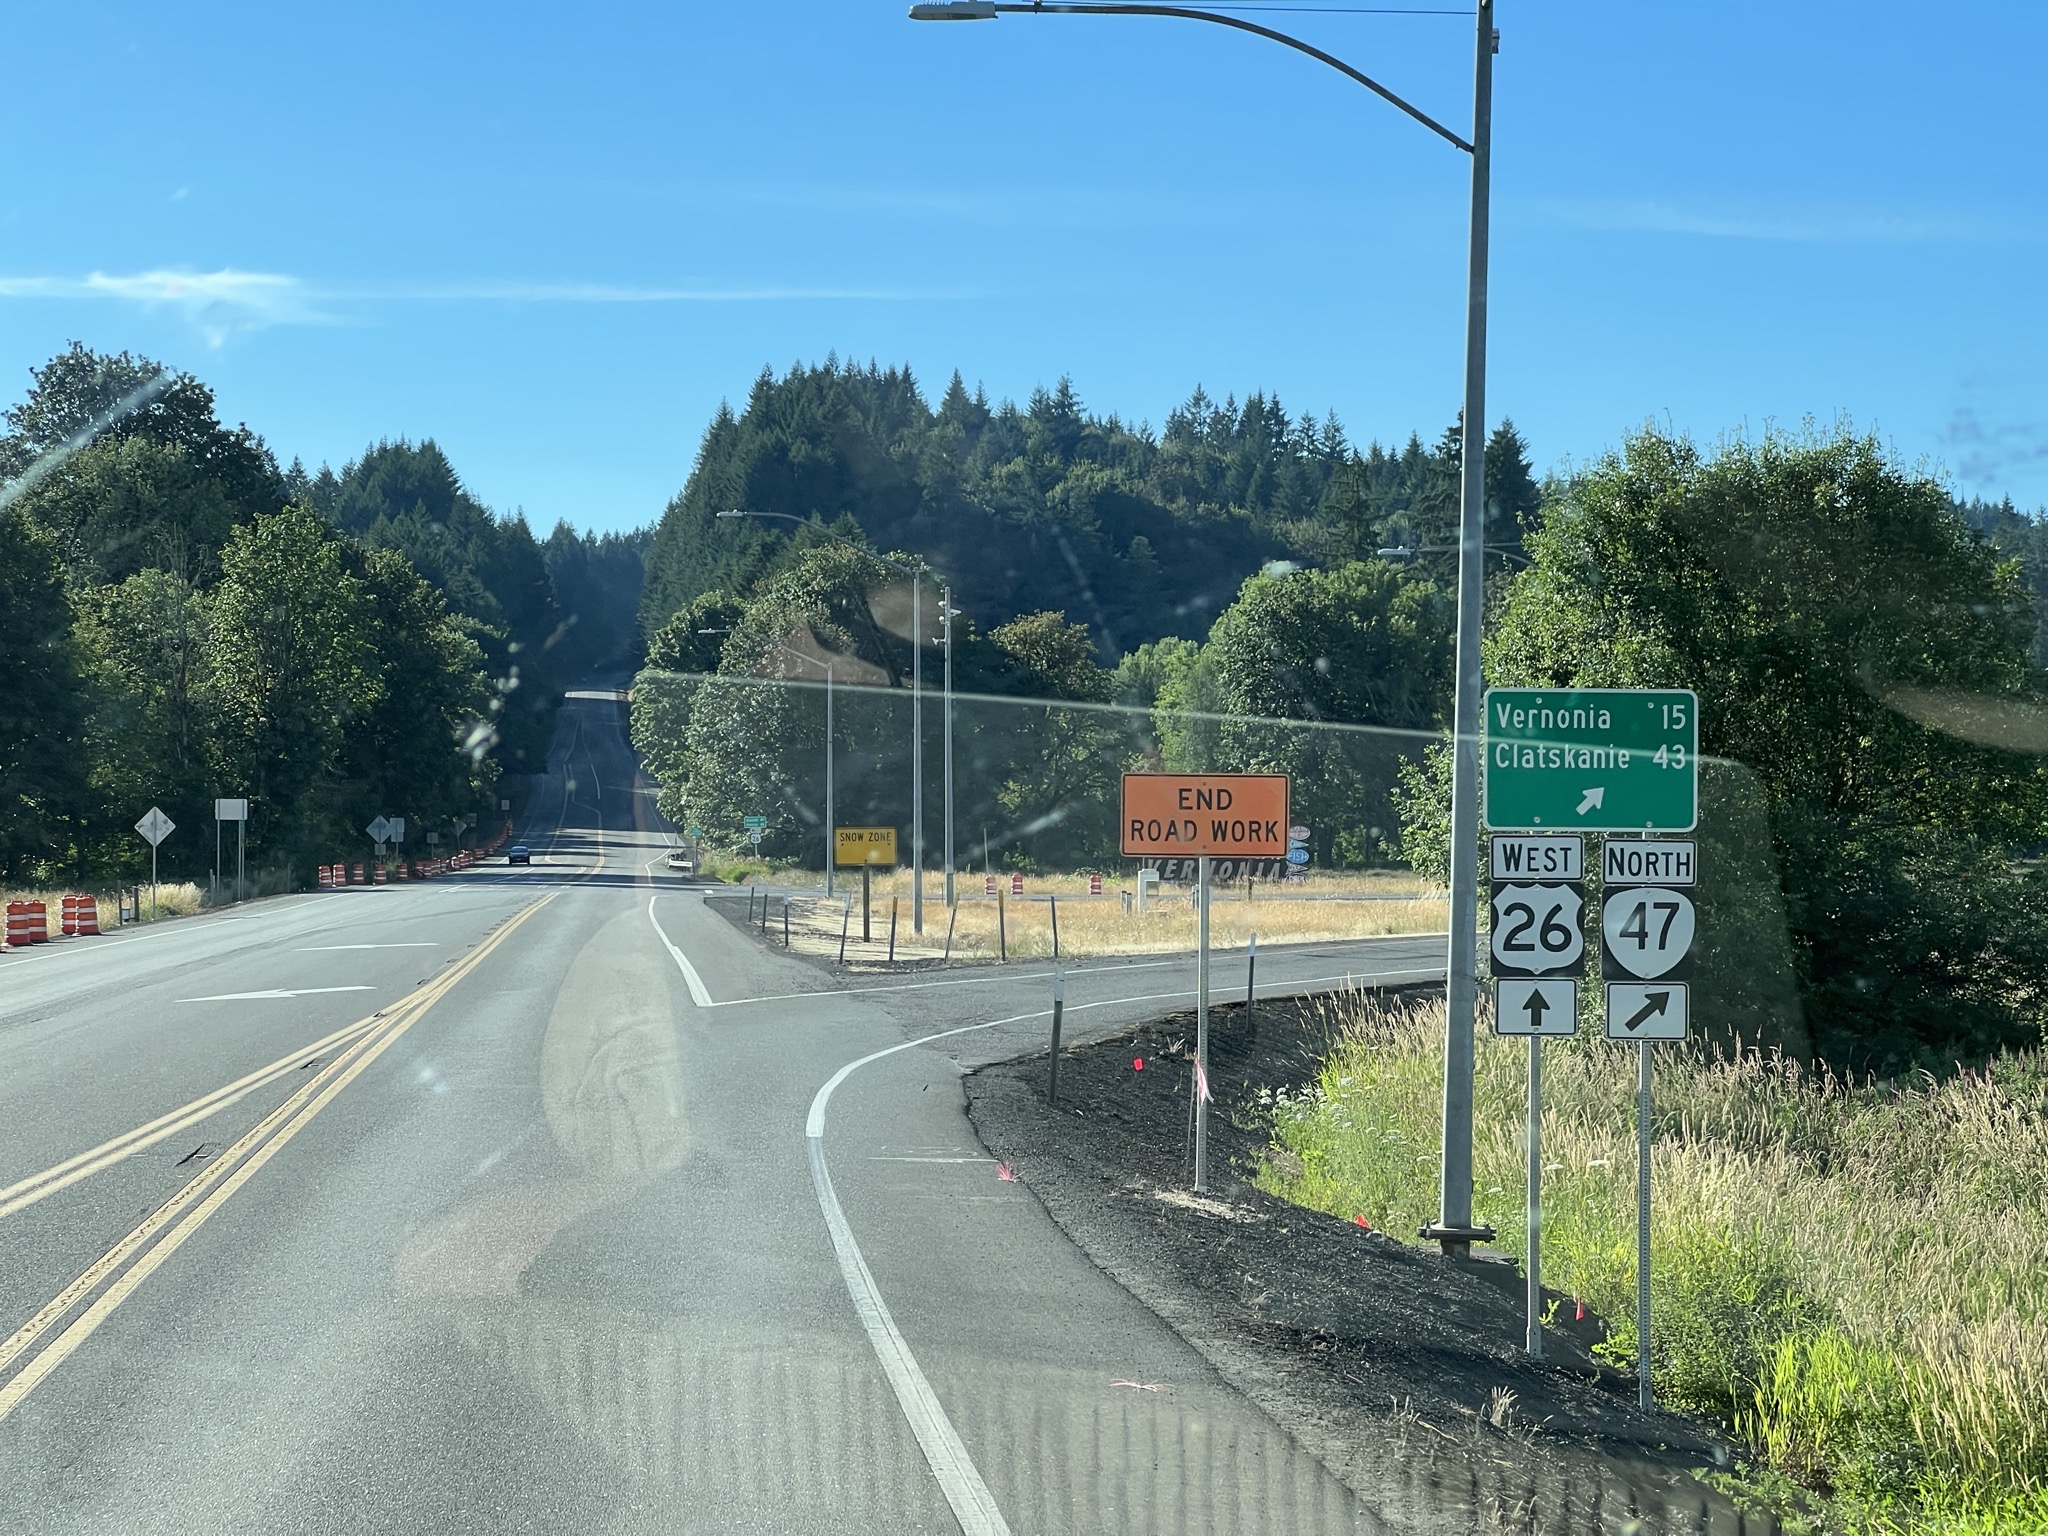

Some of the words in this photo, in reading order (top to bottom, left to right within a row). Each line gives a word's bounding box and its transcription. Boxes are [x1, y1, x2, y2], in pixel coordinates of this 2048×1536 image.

[1496, 703, 1611, 729] Vernonia
[1662, 704, 1686, 730] 15
[1495, 743, 1630, 769] Clatskanie
[1652, 744, 1686, 770] 43
[1178, 788, 1233, 811] END
[840, 832, 864, 842] SNOW
[868, 832, 892, 842] ZONE
[1131, 819, 1198, 842] ROAD
[1211, 820, 1279, 843] WORK
[1288, 851, 1308, 861] FISH
[1502, 843, 1572, 872] WEST
[1608, 847, 1690, 877] NORTH
[1503, 902, 1573, 952] 26
[1619, 902, 1680, 950] 47
